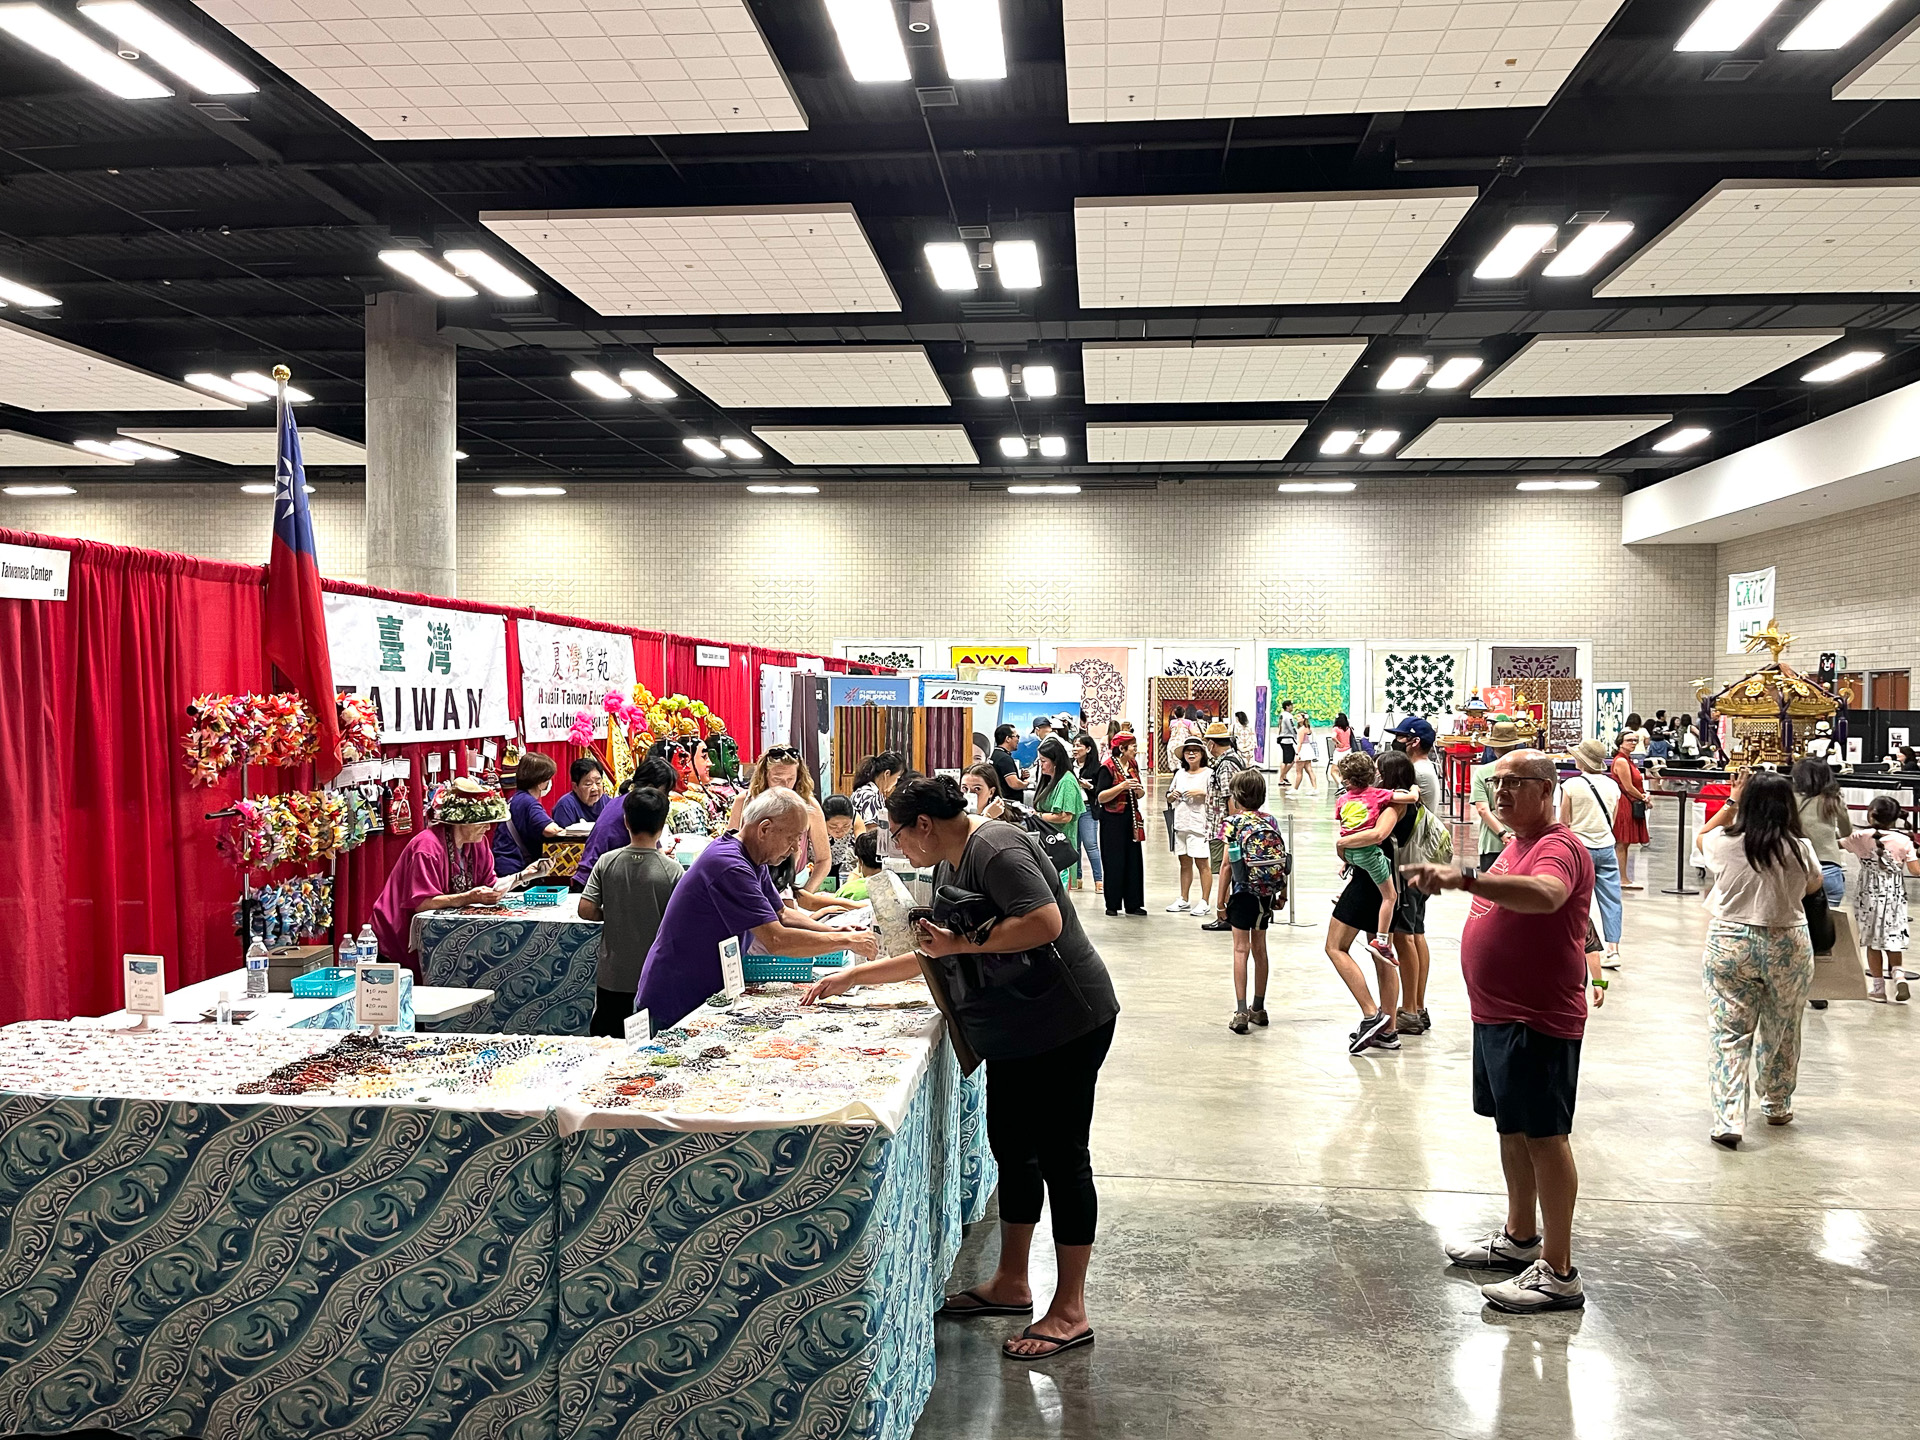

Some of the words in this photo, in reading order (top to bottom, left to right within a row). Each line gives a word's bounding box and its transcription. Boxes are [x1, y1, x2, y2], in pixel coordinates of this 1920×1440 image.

[1, 562, 29, 580] Taiwanese
[31, 565, 53, 582] Center
[1736, 578, 1766, 607] EXIT
[376, 615, 452, 675] 臺灣
[950, 694, 973, 702] Airlines
[951, 688, 980, 696] Philippine
